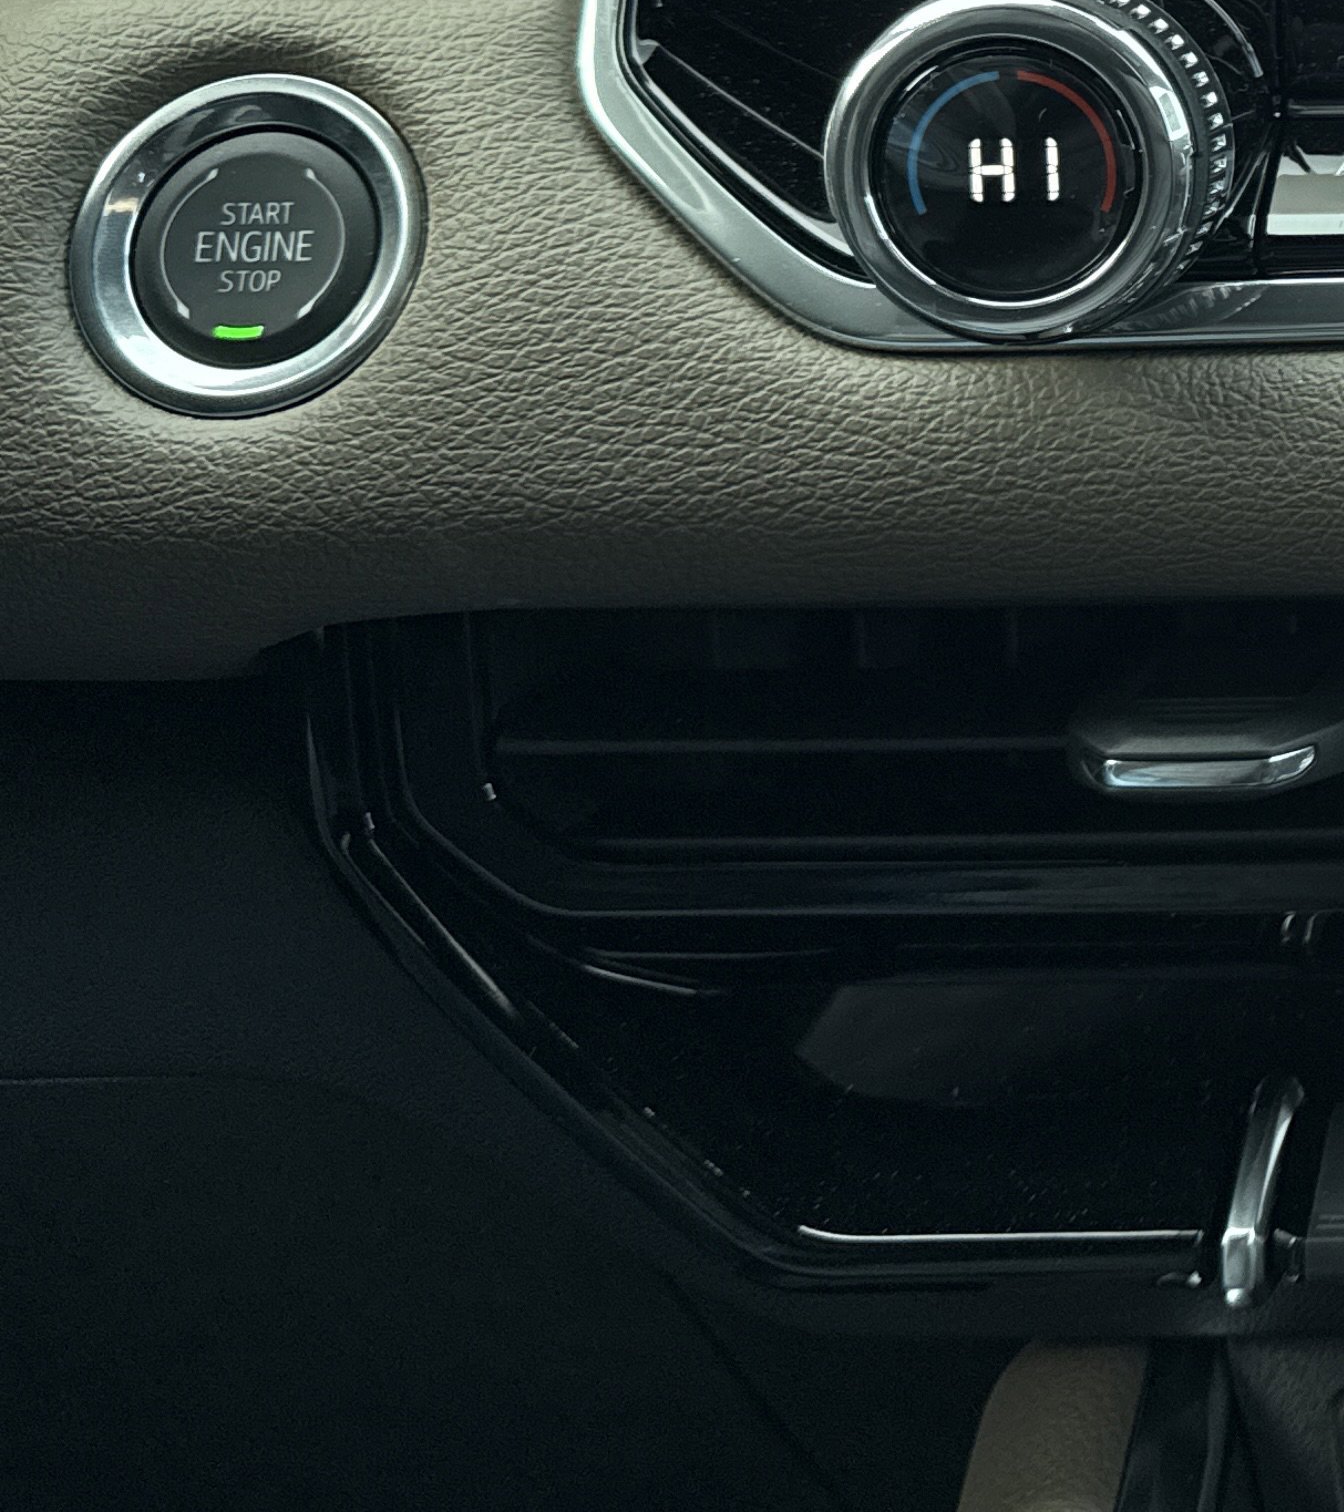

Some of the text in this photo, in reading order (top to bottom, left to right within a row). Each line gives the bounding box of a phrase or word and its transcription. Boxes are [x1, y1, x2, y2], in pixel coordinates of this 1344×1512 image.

[968, 136, 1060, 203] HI
[219, 202, 294, 226] START
[194, 230, 315, 263] ENGINE
[217, 270, 281, 293] STOP
